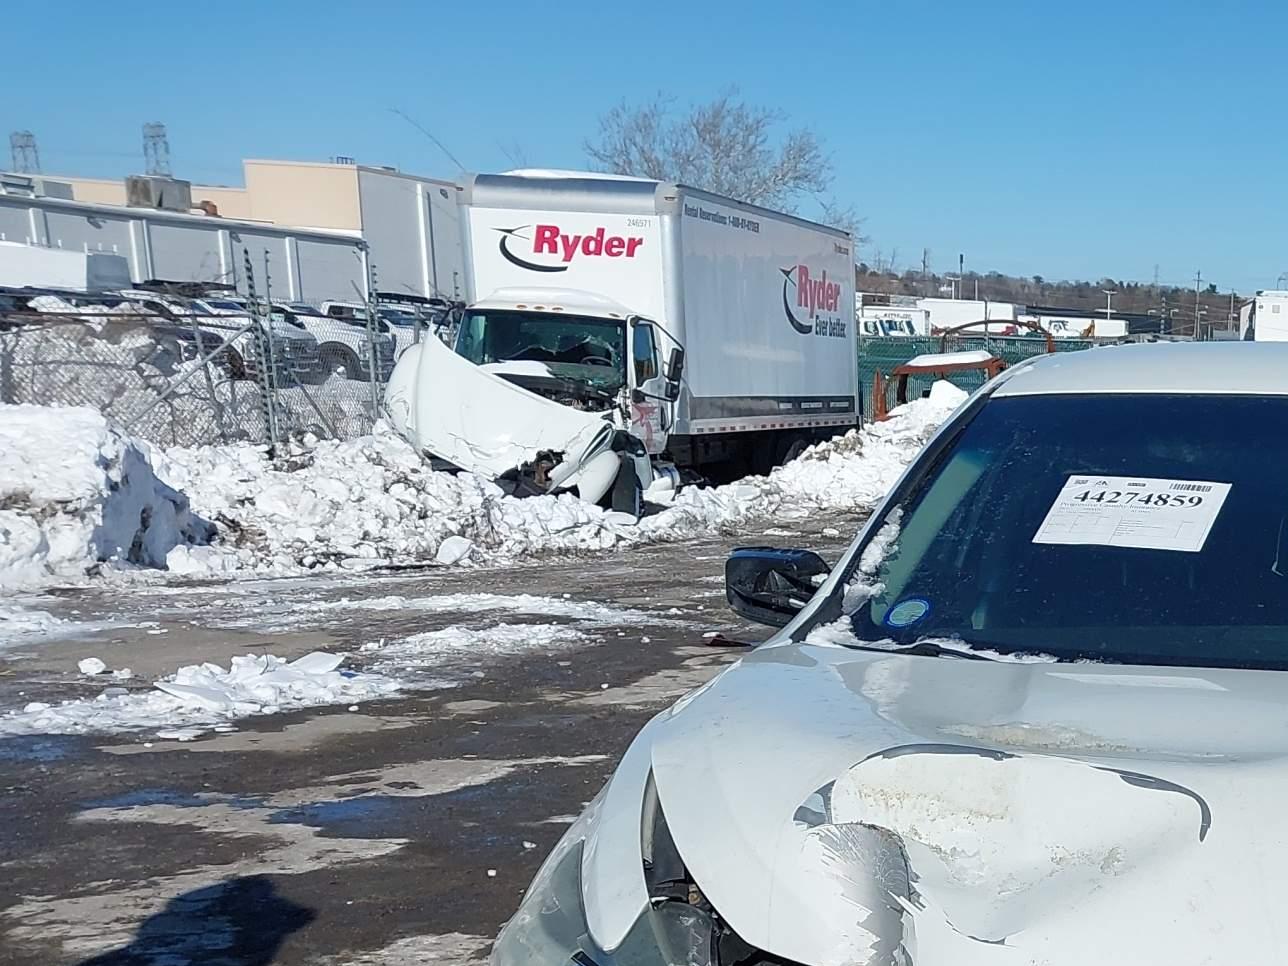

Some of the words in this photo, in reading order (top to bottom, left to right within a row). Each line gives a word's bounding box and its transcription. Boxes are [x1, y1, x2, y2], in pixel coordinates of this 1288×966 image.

[533, 224, 644, 262] Ryder
[797, 264, 841, 319] Ryder
[815, 314, 828, 337] Ever
[1073, 489, 1204, 509] 44274859
